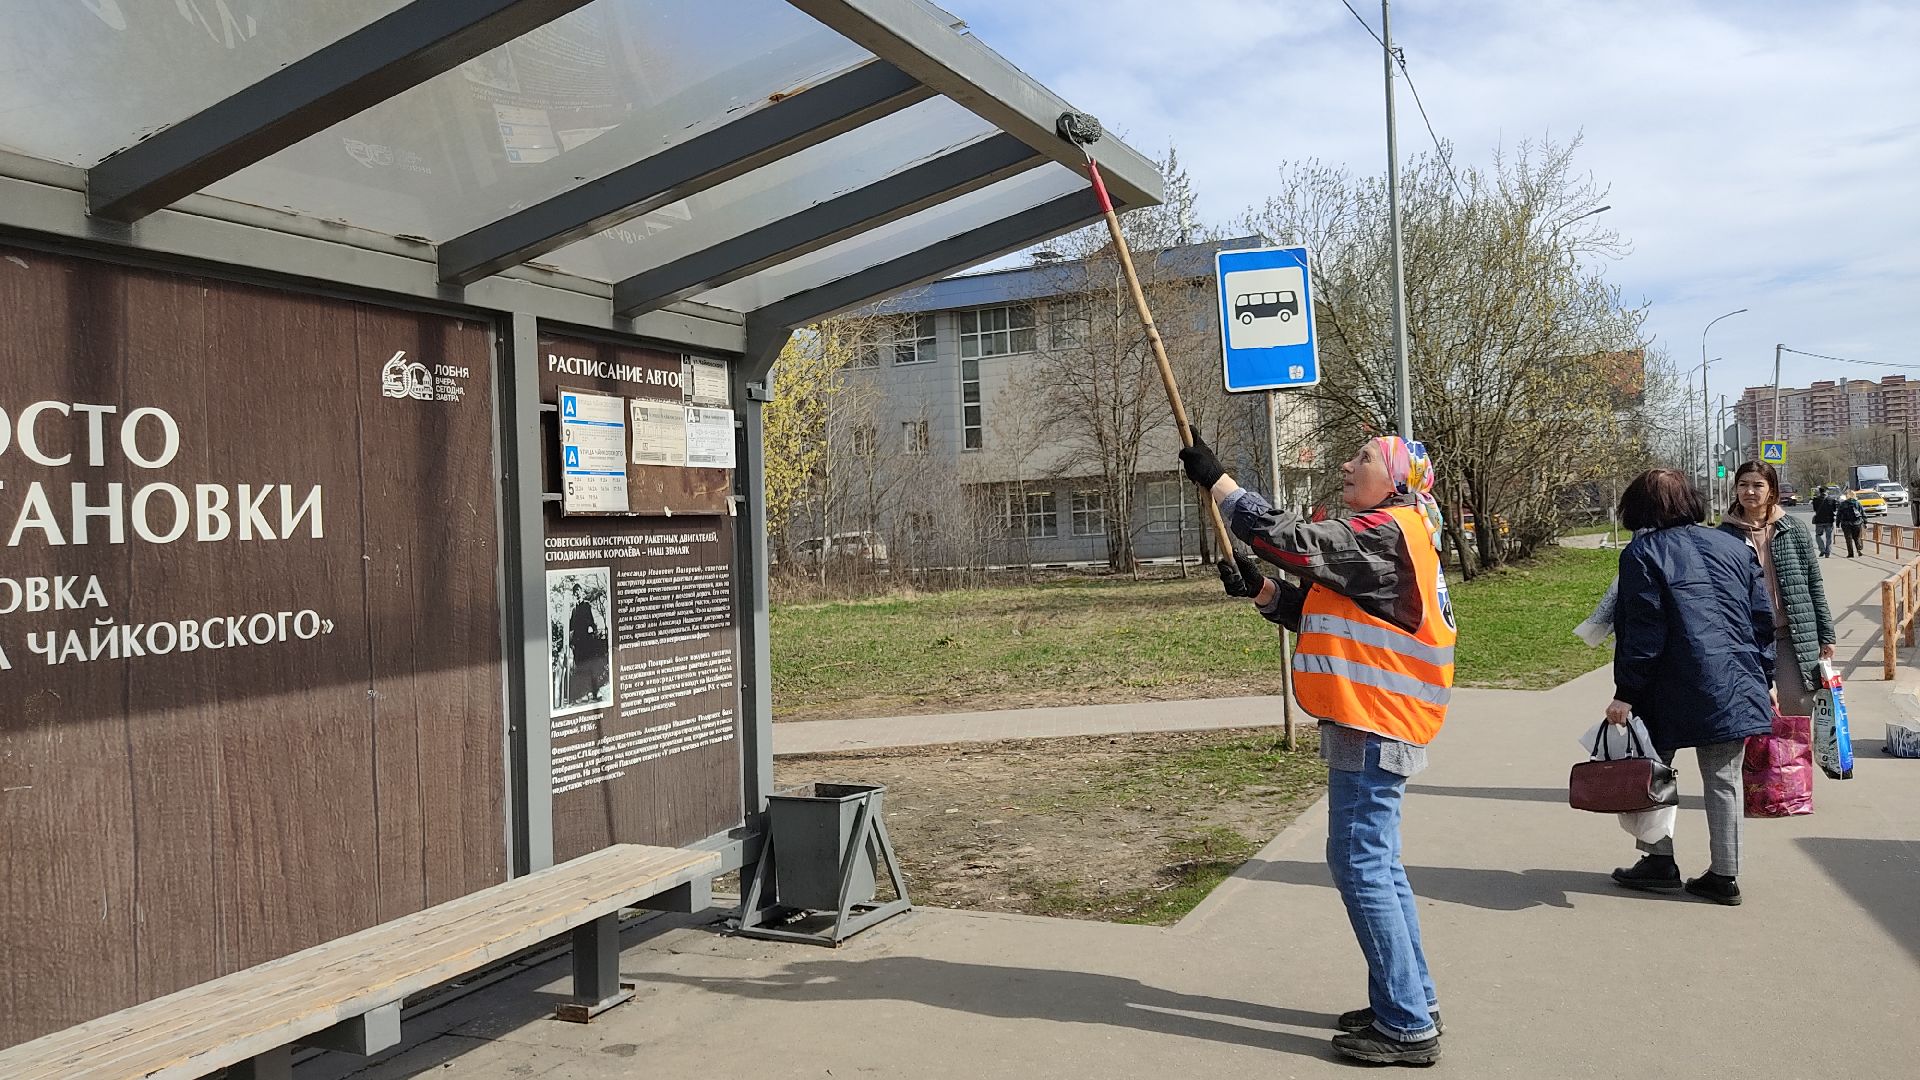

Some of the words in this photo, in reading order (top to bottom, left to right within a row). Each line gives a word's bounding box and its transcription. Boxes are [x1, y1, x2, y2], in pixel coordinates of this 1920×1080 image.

[434, 364, 470, 378] ЛОБНЯ
[548, 354, 643, 384] РАСПИСАНИЕ
[435, 385, 465, 395] СЕГОДНЯ,
[435, 394, 460, 402] ЗАВТРА
[0, 400, 180, 469] СТО
[566, 429, 571, 442] 9
[568, 482, 574, 496] 5
[0, 480, 324, 547] АНОВКИ
[545, 534, 591, 548] СОВЕТСКИЙ
[592, 535, 644, 546] КОНСТРУКТОР
[644, 533, 679, 545] РАКЕТНЫХ
[679, 532, 719, 544] ДВИГАТЕЛЕЙ,
[545, 548, 602, 562] СПОДВИЖНИК
[603, 545, 641, 559] КОРОЛЁВА
[647, 545, 664, 557] НАШ
[665, 545, 690, 556] ЗЕМЛЯК
[27, 609, 334, 665] ЧАЙКОВСКОГО»
